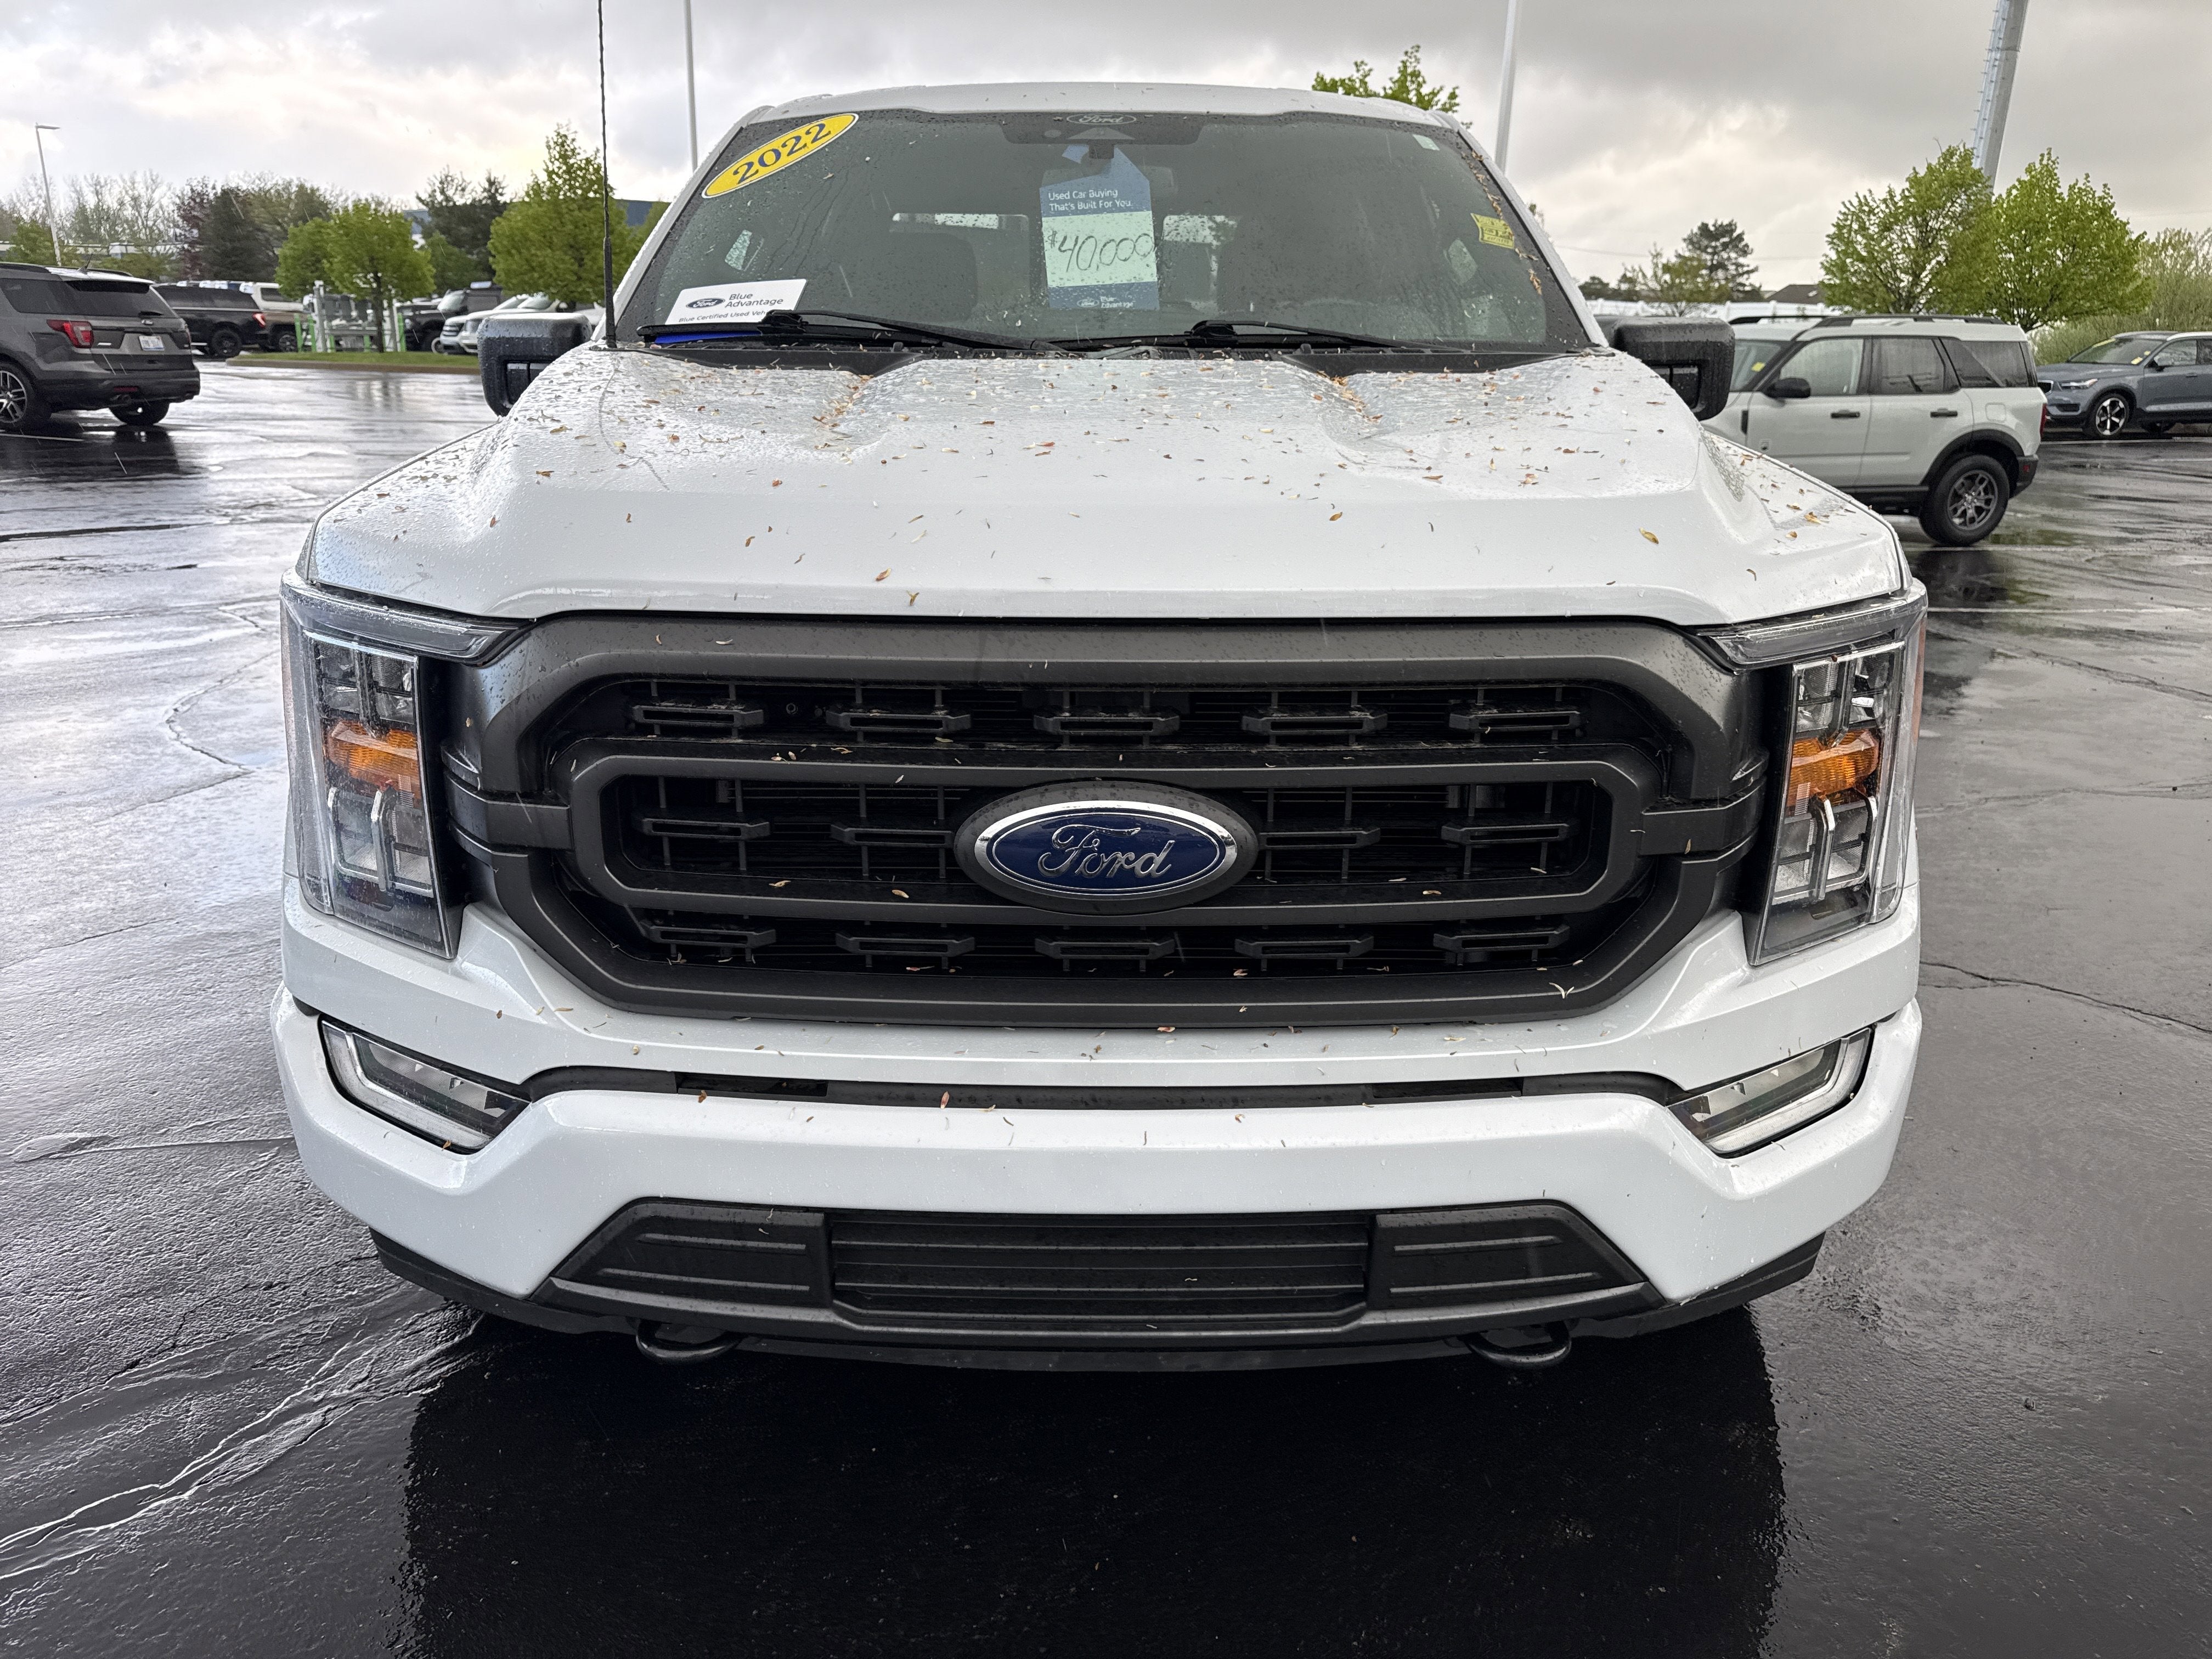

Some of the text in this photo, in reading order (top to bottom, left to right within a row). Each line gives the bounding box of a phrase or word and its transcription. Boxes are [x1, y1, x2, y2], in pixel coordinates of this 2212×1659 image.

[1079, 115, 1124, 123] Ford
[733, 123, 831, 184] 2022
[1048, 189, 1118, 201] Used Car Buying
[1049, 202, 1075, 211] That's
[1077, 200, 1097, 210] Built
[692, 299, 718, 308] Ford
[724, 298, 783, 308] Advantage
[1037, 825, 1175, 878] Ford
